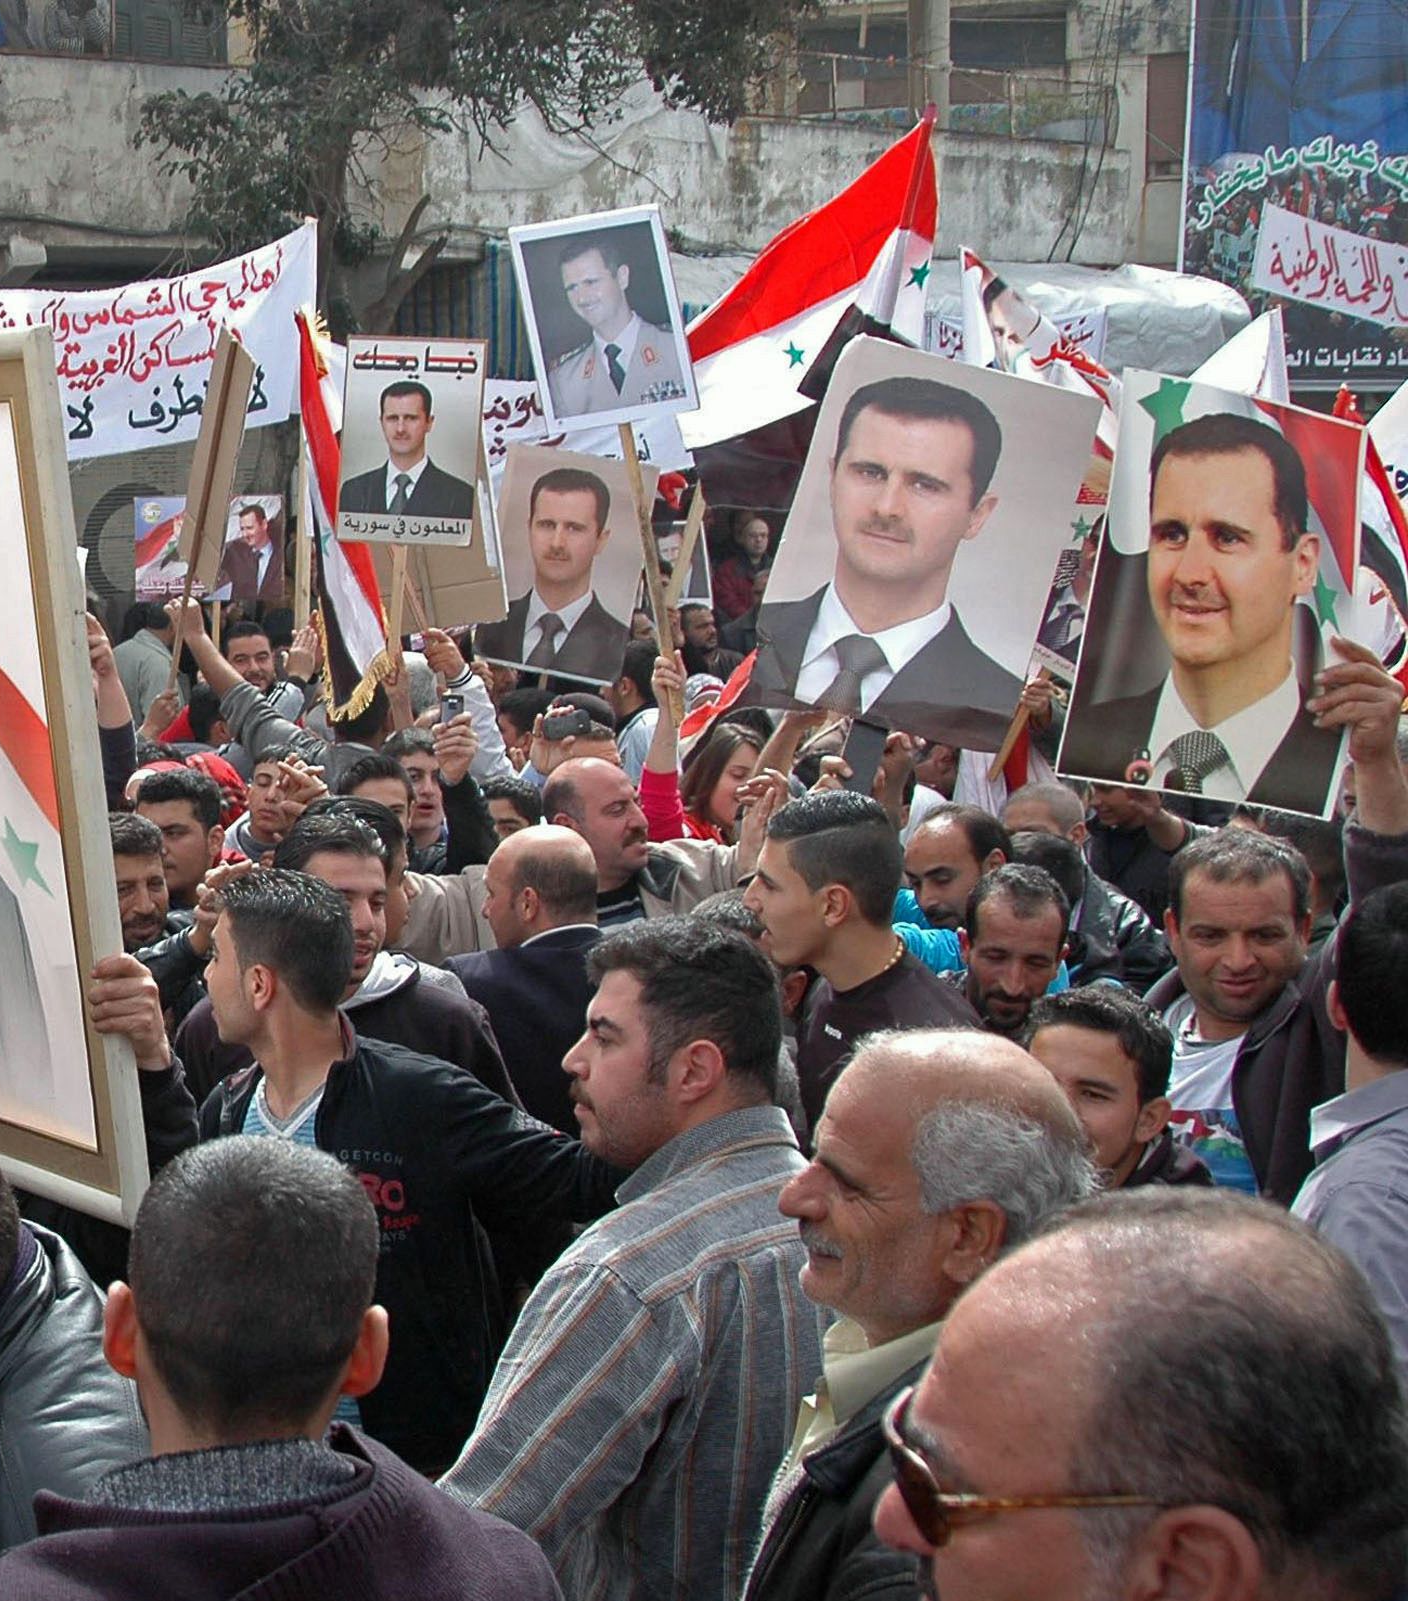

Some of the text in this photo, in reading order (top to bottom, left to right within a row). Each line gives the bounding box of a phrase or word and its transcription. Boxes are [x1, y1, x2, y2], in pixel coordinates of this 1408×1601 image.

[1298, 135, 1379, 177] غيرك
[1269, 222, 1340, 299] الوطنية
[1285, 348, 1310, 367] الع
[1313, 346, 1382, 373] نقابات
[344, 514, 390, 533] سورية
[409, 520, 466, 537] المعلمون
